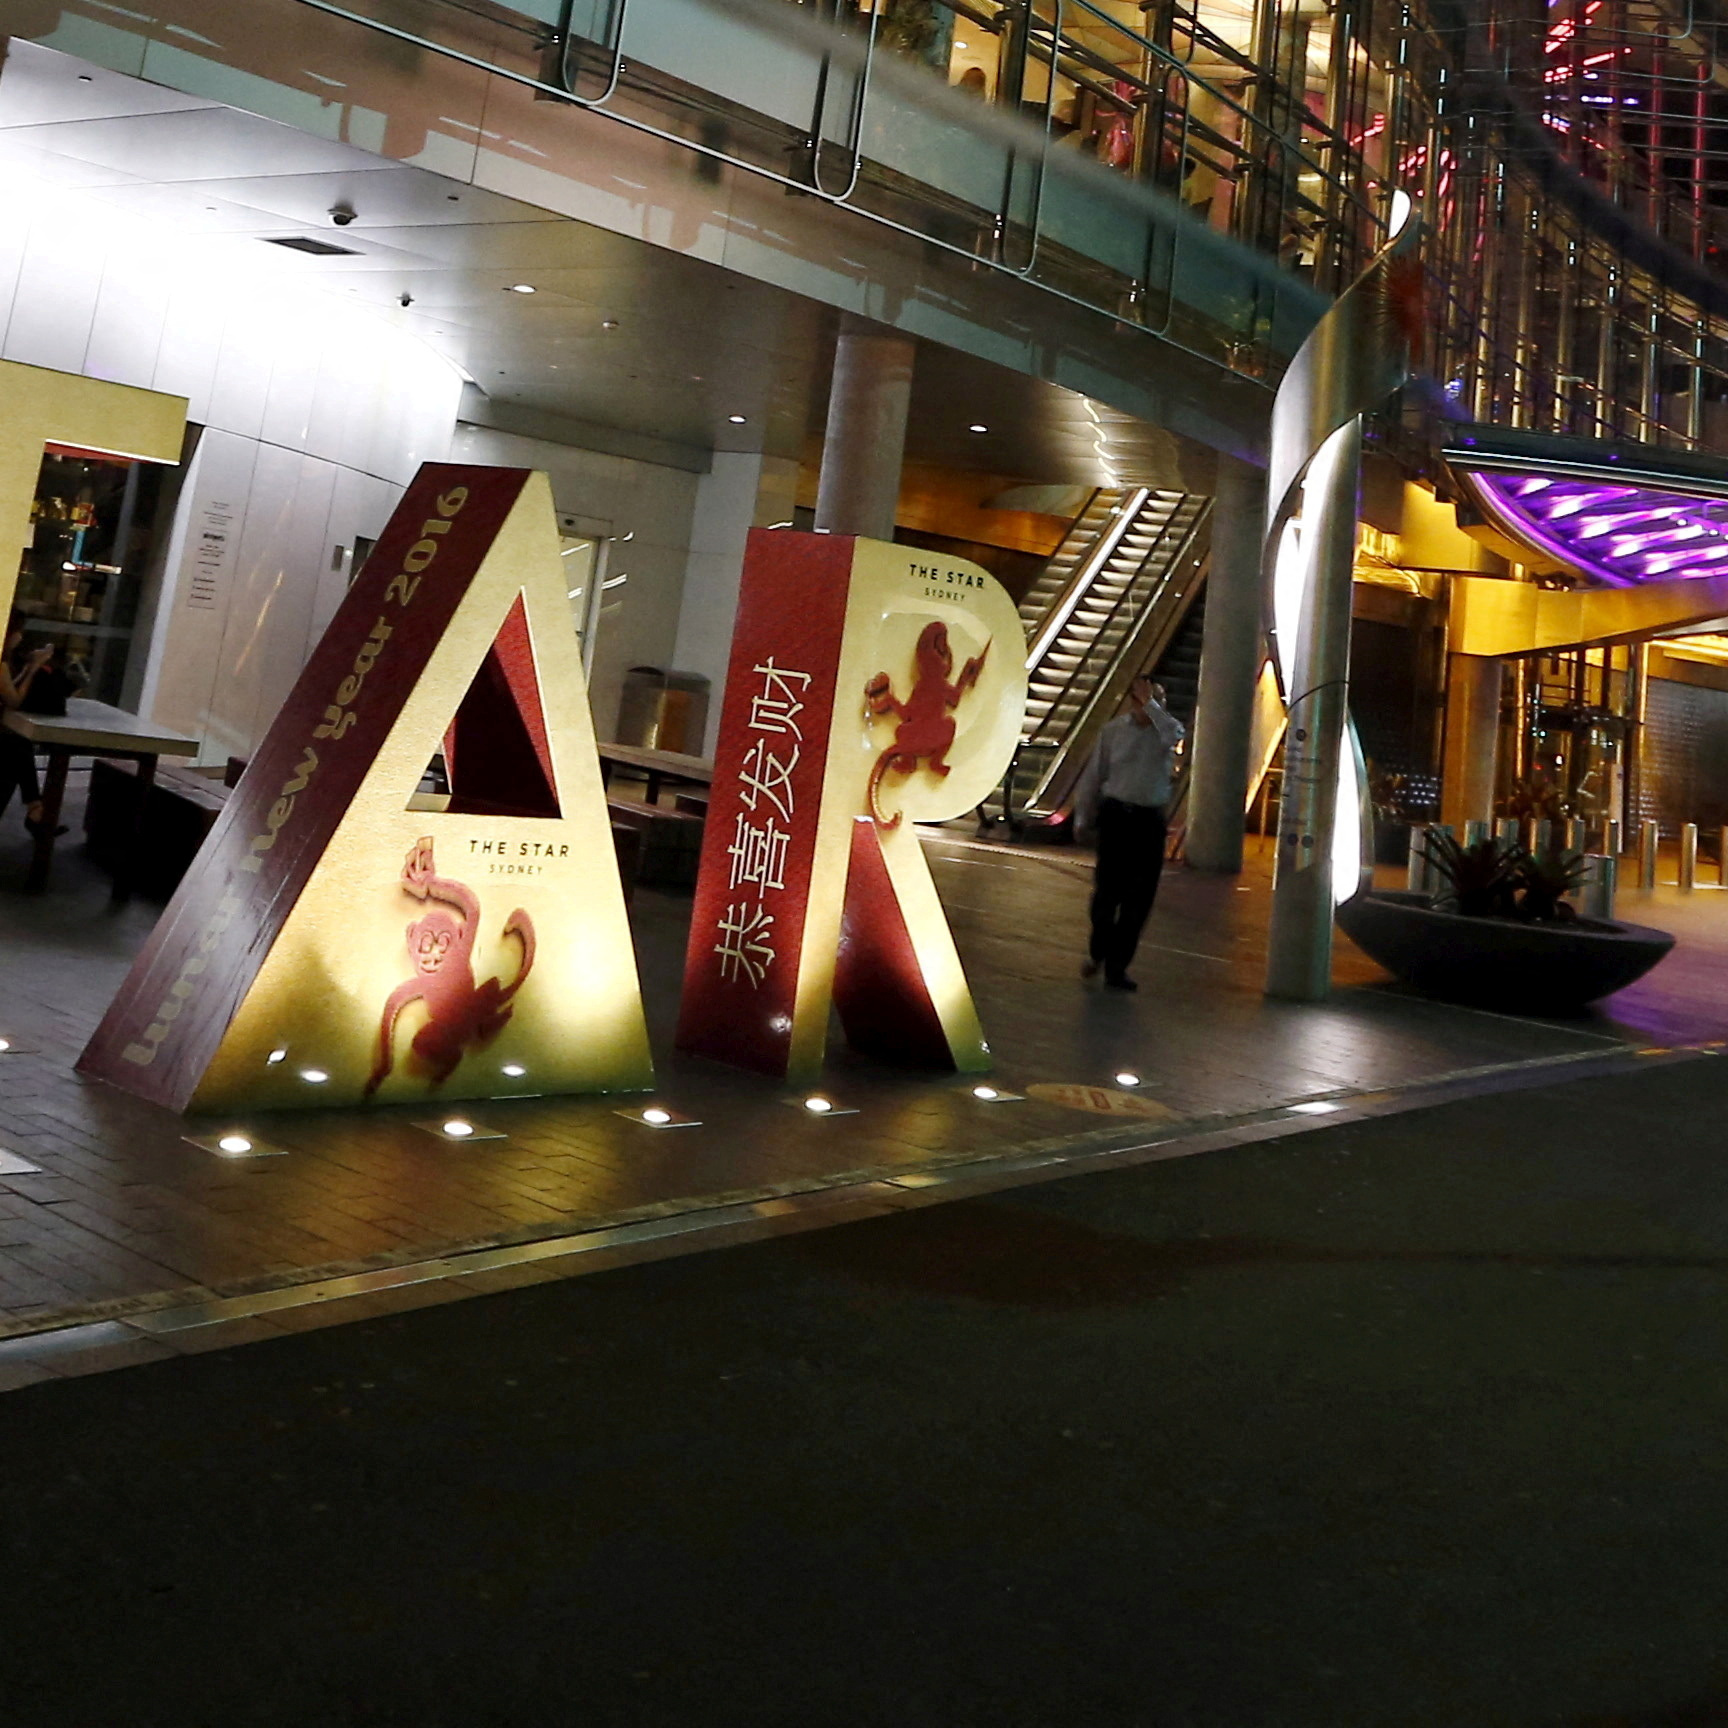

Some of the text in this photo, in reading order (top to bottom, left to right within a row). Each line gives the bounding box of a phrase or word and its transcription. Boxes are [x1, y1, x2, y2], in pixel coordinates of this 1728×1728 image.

[909, 564, 984, 589] THE STAR
[924, 587, 965, 602] SYDNEY
[313, 615, 395, 741] year
[384, 484, 470, 608] 2016
[713, 655, 815, 990] 恭喜发财
[469, 839, 569, 857] THE STAR
[489, 864, 543, 874] SYDNEY
